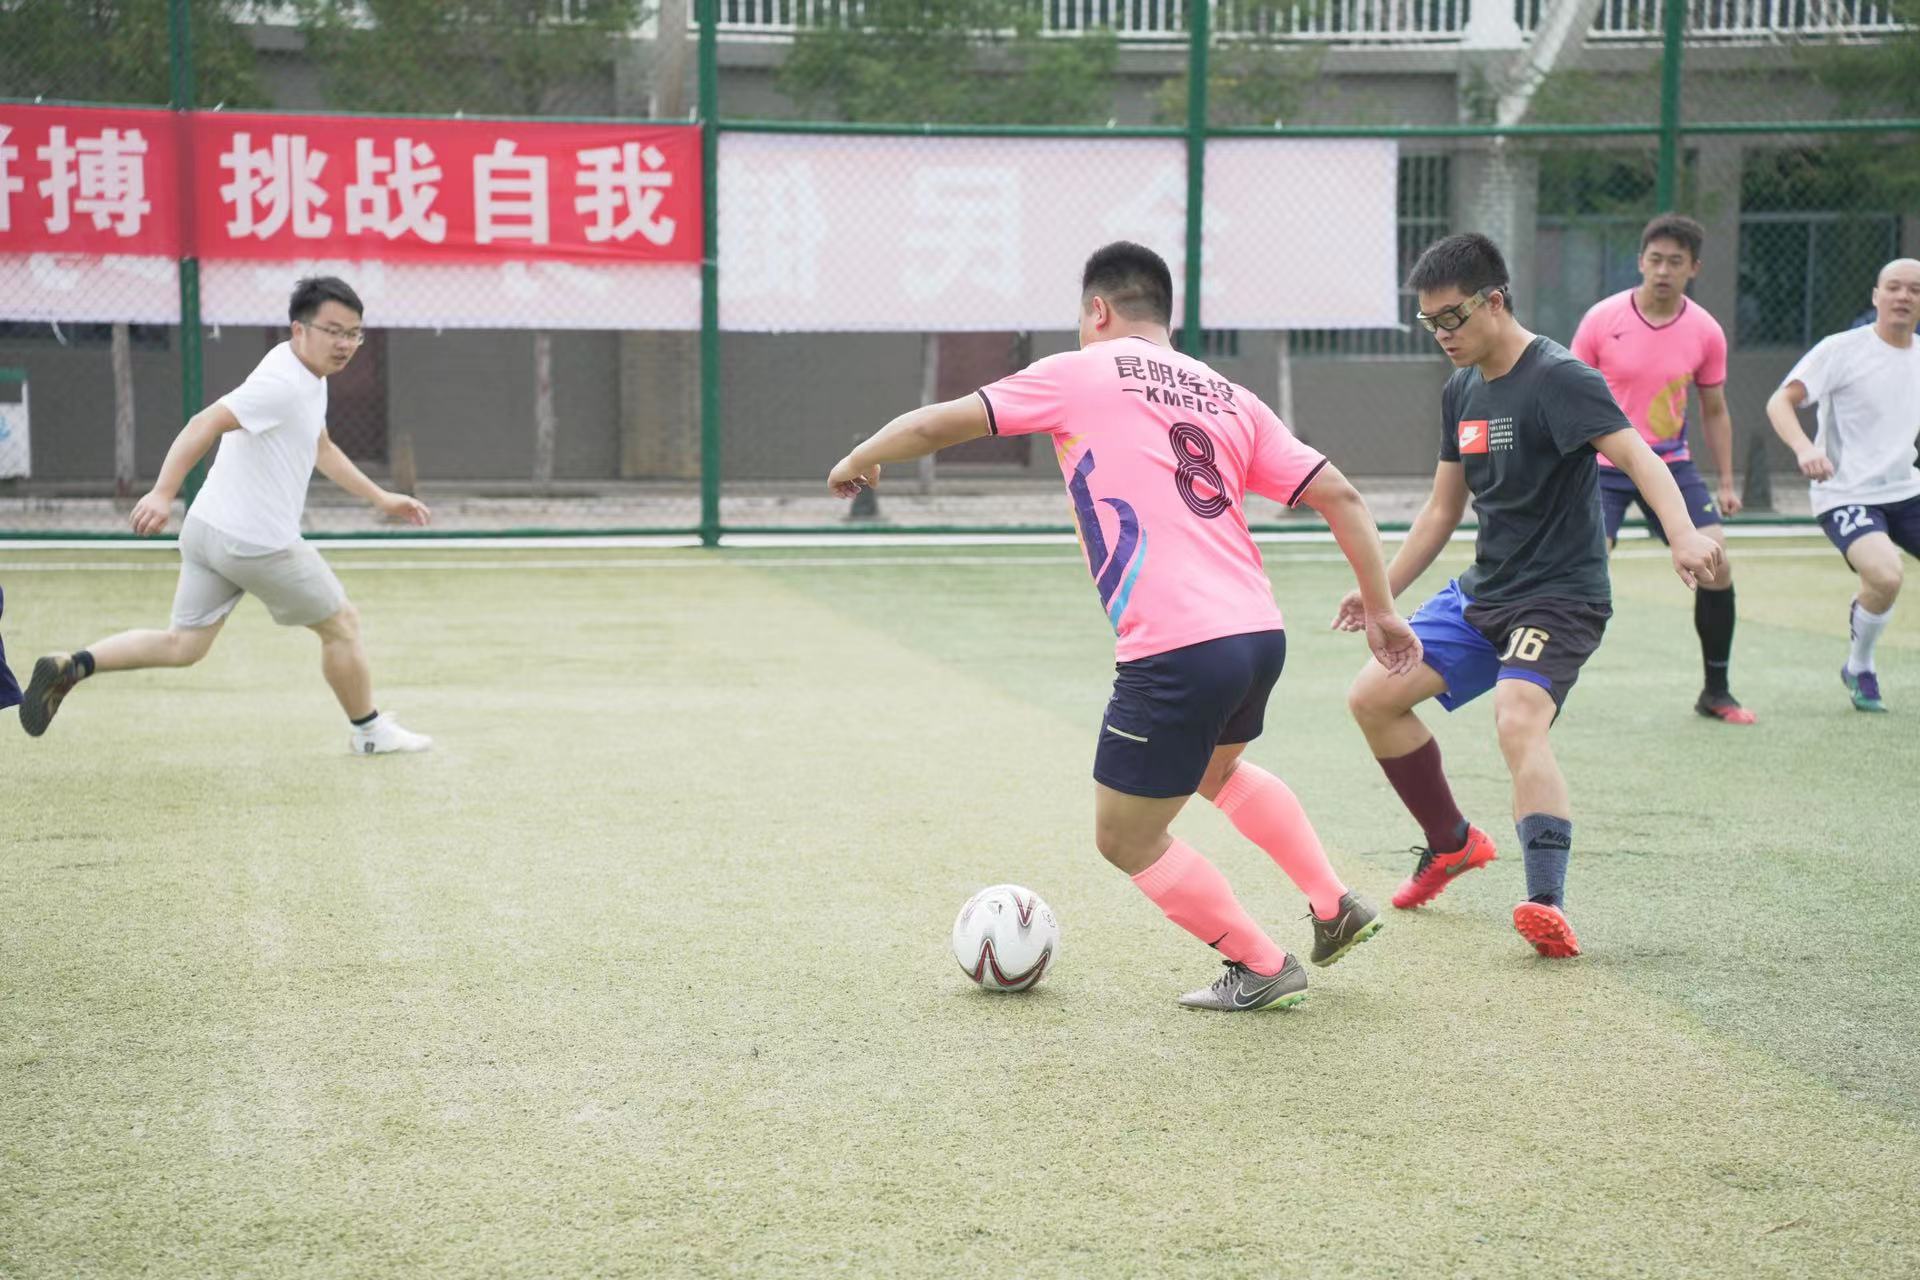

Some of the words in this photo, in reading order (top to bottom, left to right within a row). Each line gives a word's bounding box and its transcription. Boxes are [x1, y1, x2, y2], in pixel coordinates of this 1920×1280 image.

[217, 132, 676, 246] 挑战自我
[1145, 386, 1220, 416] KMEIC
[1169, 422, 1232, 520] 8
[1833, 505, 1874, 537] 22
